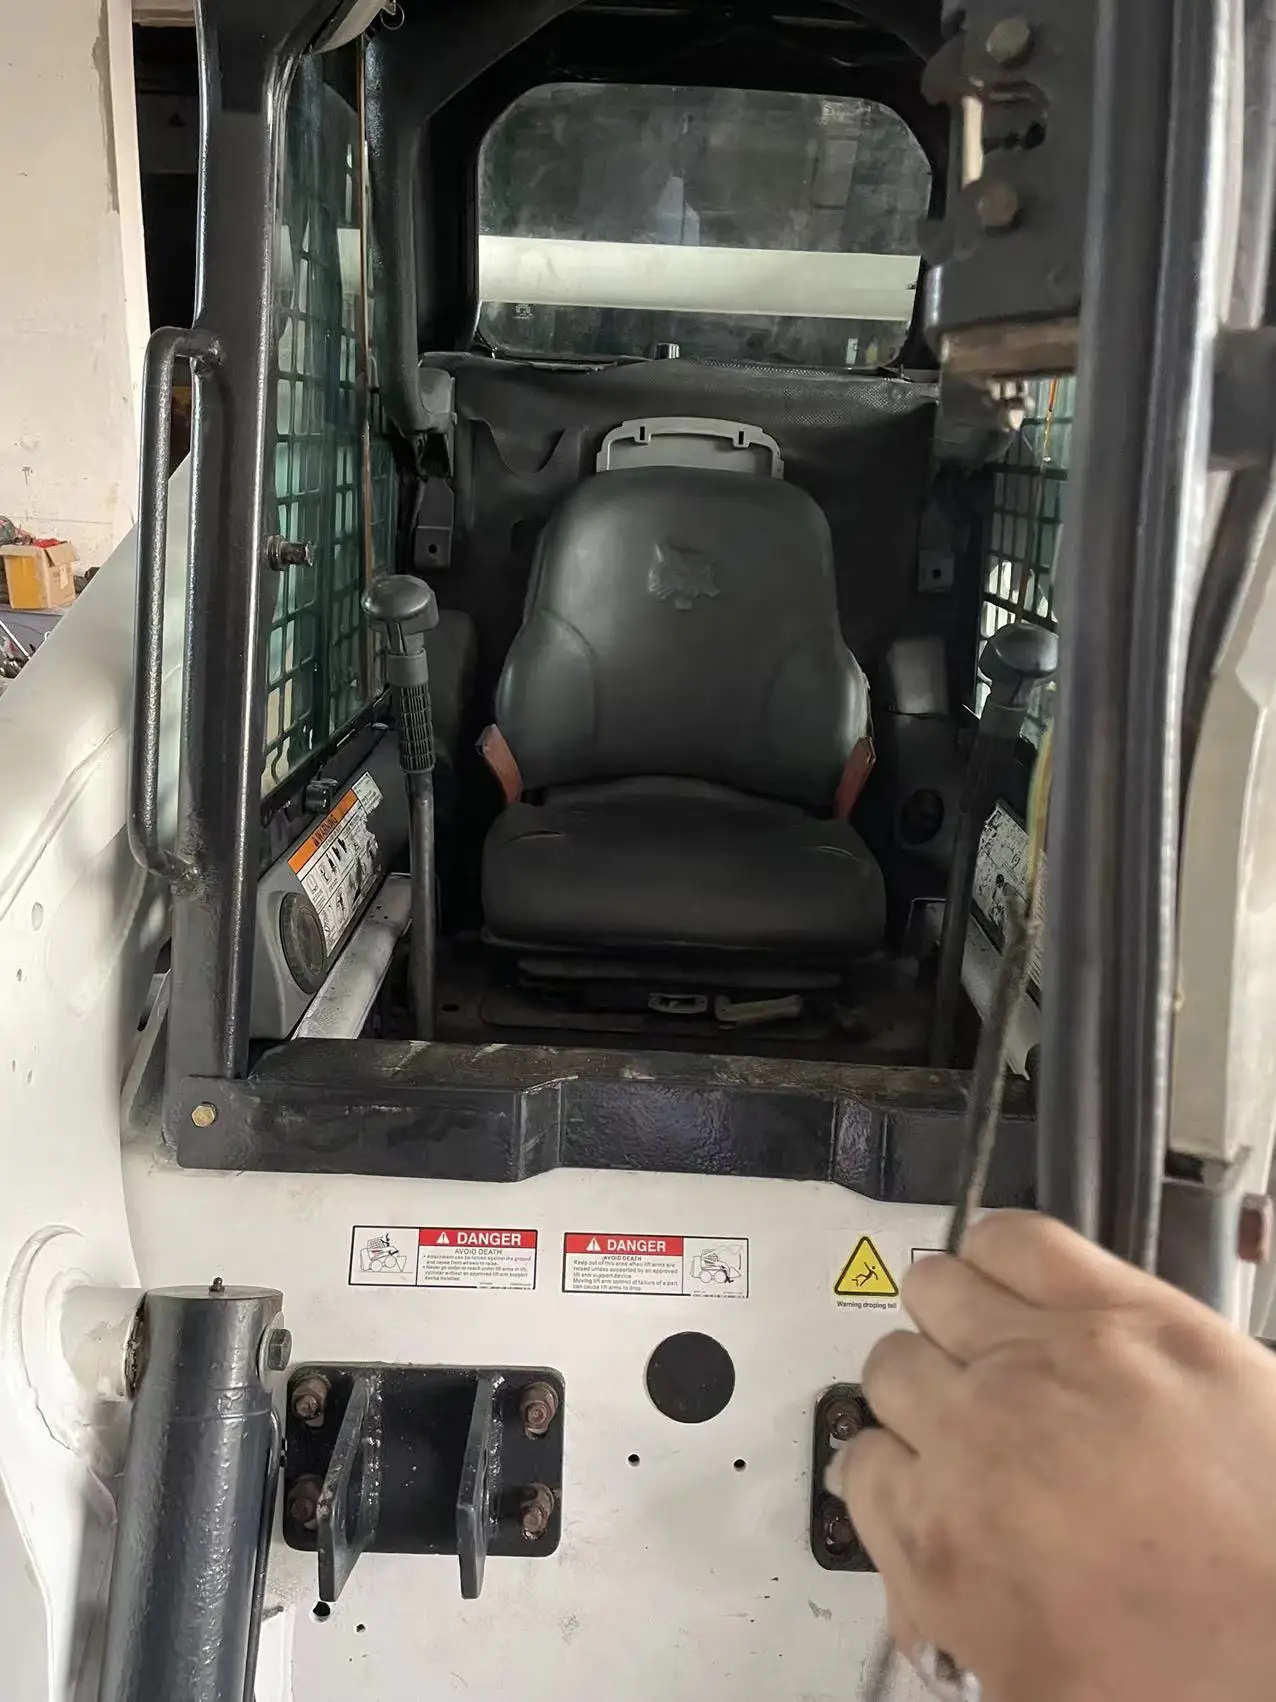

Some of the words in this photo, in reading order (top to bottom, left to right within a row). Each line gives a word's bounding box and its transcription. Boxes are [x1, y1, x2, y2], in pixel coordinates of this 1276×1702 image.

[314, 813, 338, 843] WARNING
[457, 1231, 521, 1246] DANGER
[607, 1239, 666, 1252] DANGER
